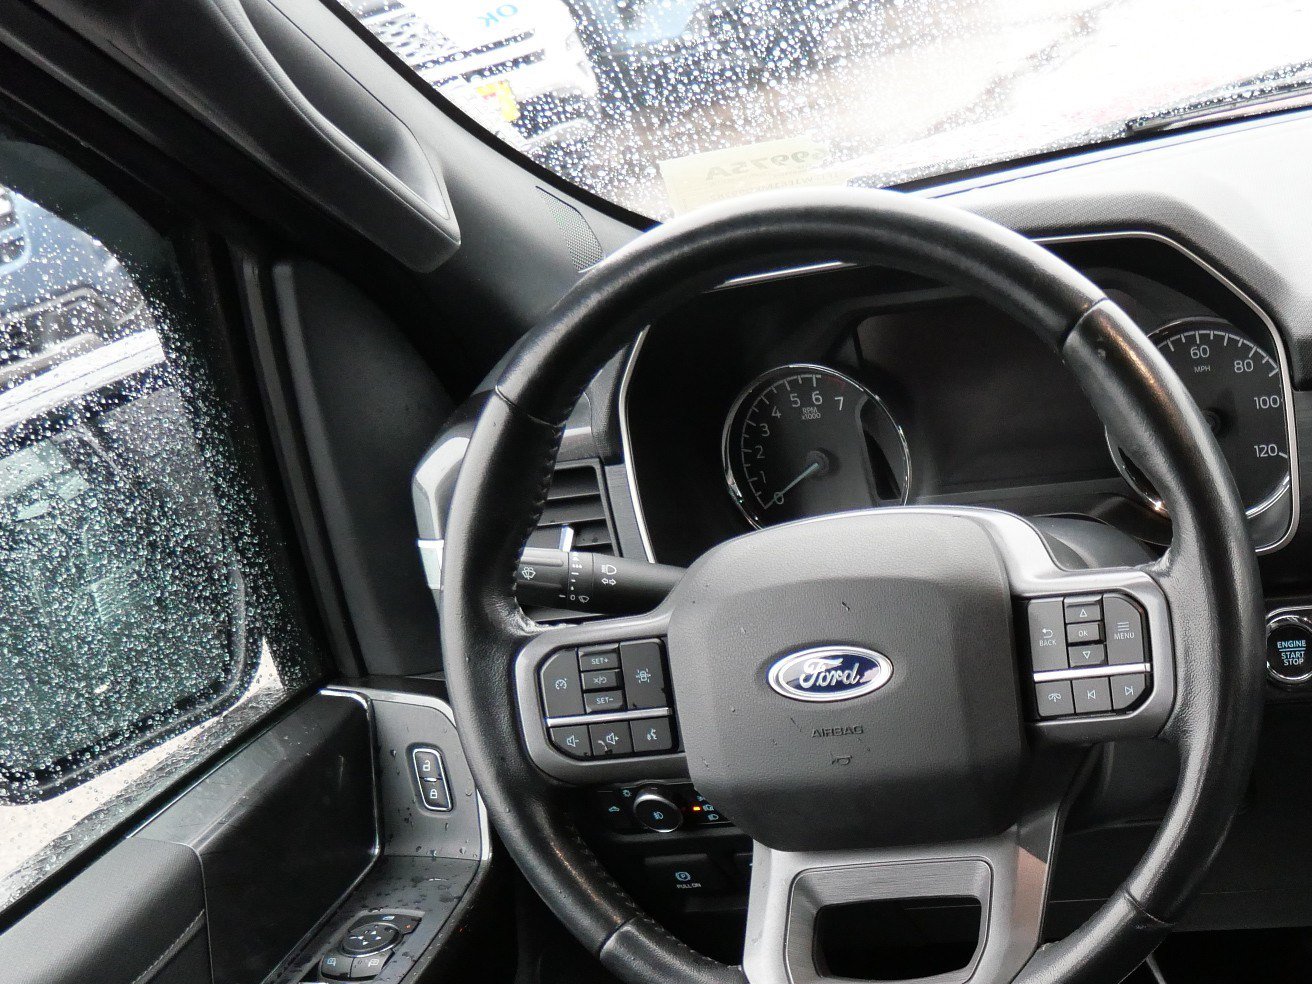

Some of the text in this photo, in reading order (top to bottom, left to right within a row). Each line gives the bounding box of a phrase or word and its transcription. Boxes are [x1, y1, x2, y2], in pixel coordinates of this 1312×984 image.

[1190, 345, 1209, 359] 60
[1234, 359, 1254, 373] 80
[790, 394, 801, 407] 5
[812, 391, 822, 405] 6
[835, 397, 843, 410] 7
[1254, 396, 1280, 409] 100
[772, 406, 781, 418] 4
[760, 424, 770, 436] 3
[755, 446, 765, 457] 2
[1254, 444, 1277, 458] 120
[760, 471, 767, 483] 1
[1114, 632, 1134, 640] MENU
[1277, 640, 1306, 648] ENGINE
[1281, 651, 1305, 659] START
[799, 657, 860, 688] Ford
[812, 726, 864, 738] AIRBAG
